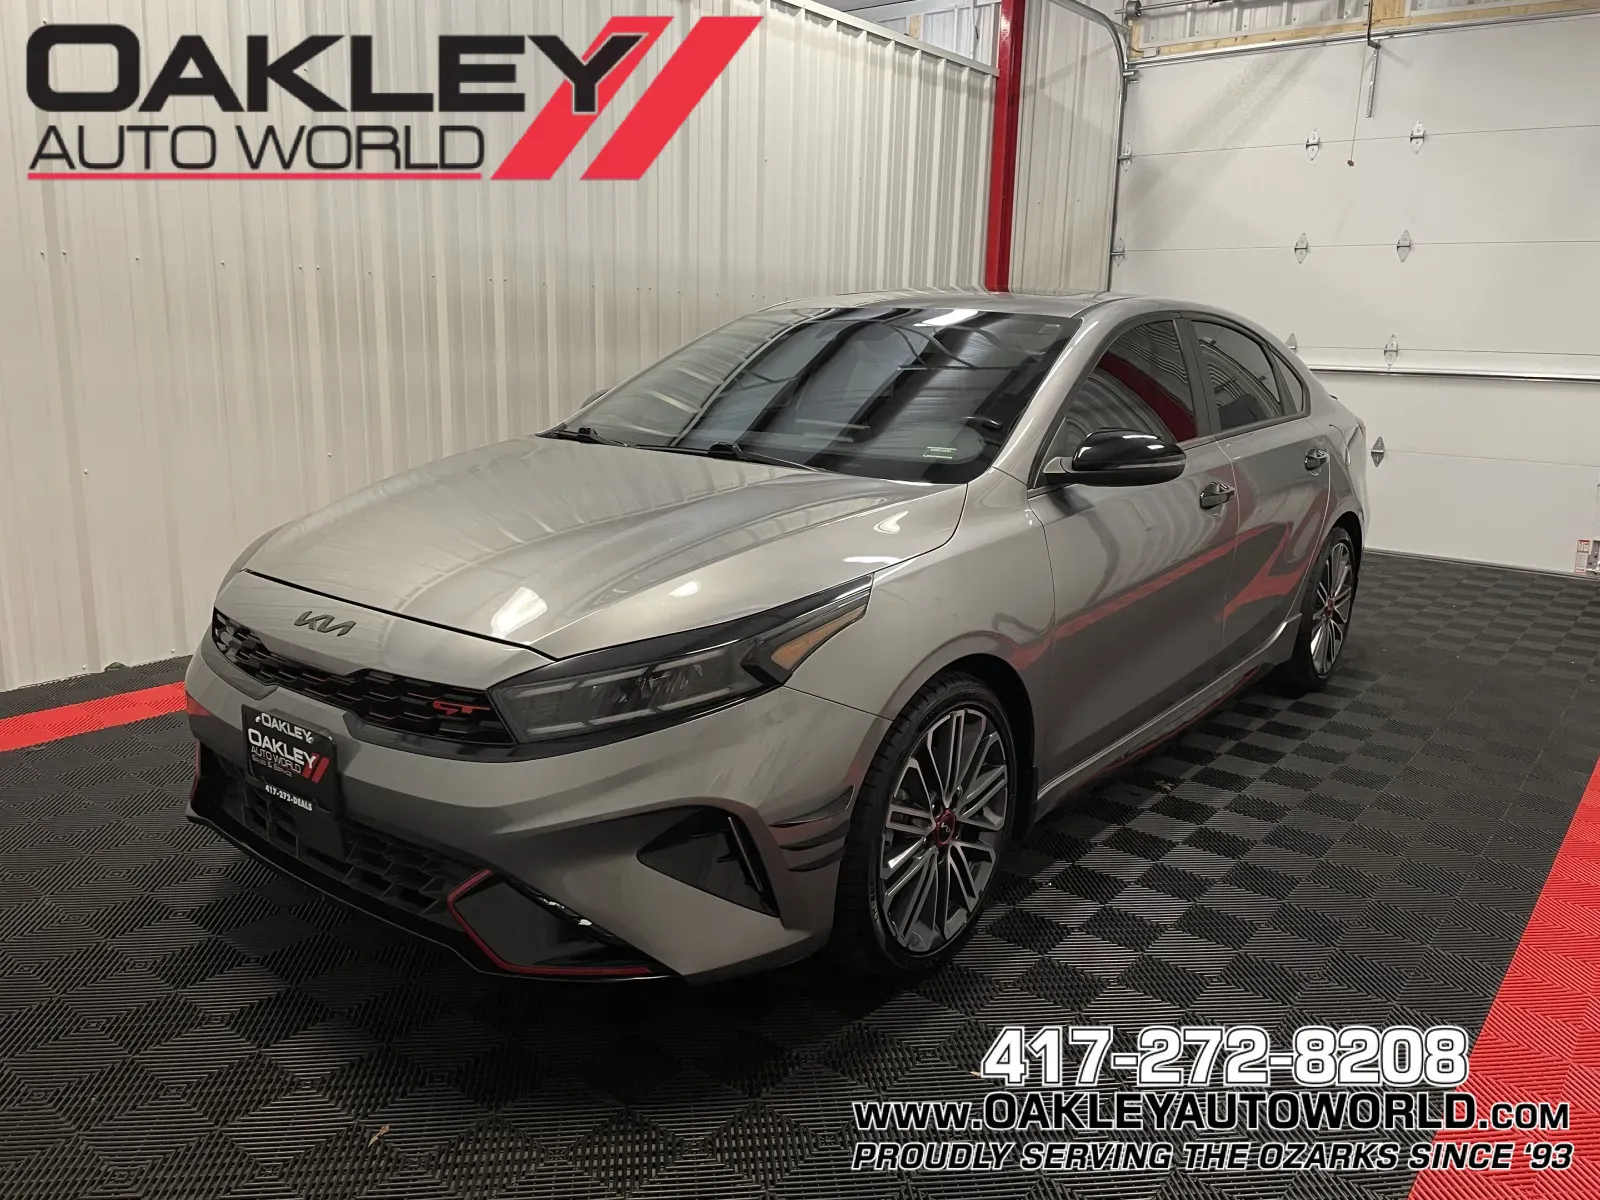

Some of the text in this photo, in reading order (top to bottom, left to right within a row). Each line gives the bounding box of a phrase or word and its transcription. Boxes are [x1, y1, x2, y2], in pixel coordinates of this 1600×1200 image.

[294, 610, 357, 637] KIA
[432, 700, 491, 715] GT
[261, 712, 314, 743] OAKLEY
[247, 728, 317, 769] OAKLEY
[251, 745, 302, 774] AUTO WORLD
[265, 784, 313, 812] 417-272-DEALS
